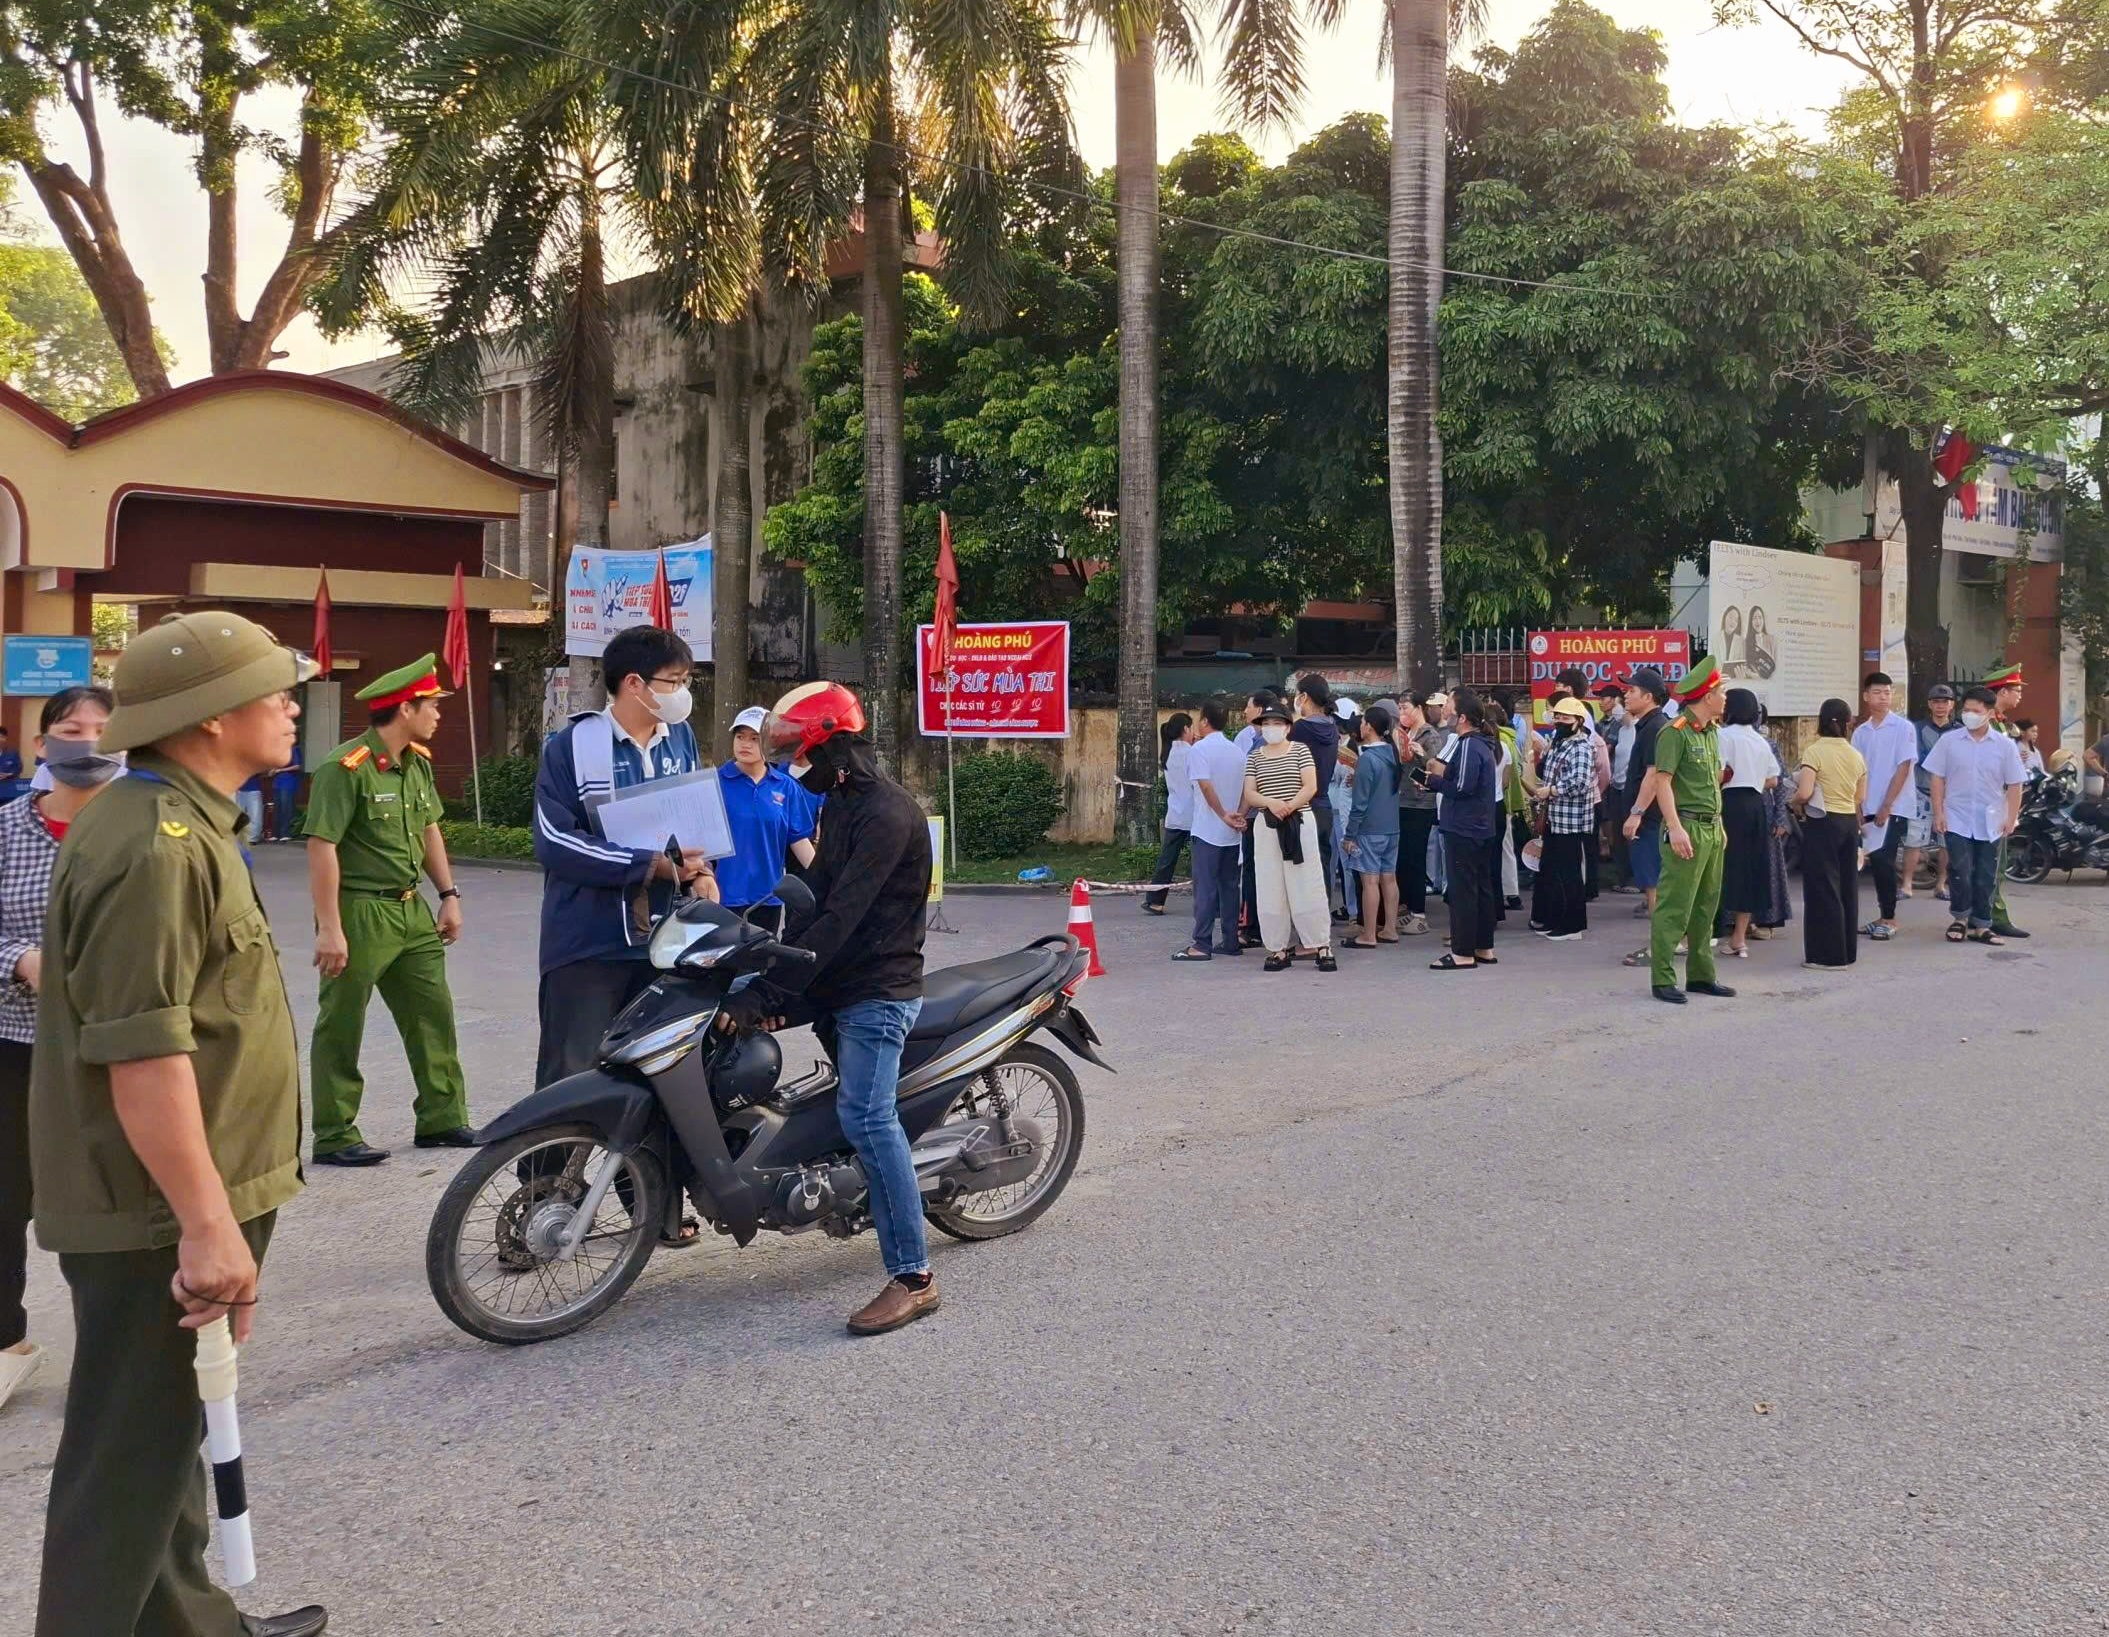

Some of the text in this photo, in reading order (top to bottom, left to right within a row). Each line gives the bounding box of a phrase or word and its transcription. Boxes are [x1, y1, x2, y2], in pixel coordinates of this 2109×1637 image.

[955, 630, 1032, 649] HOÀNG PHÚ
[1559, 636, 1618, 654] HOÀNG
[1622, 635, 1657, 654] PHÚ
[962, 669, 990, 693] SỨC
[992, 666, 1025, 694] MÙA
[1028, 671, 1056, 692] THI
[1532, 661, 1563, 681] DU
[939, 700, 955, 710] CHC
[956, 700, 968, 710] CÁC
[991, 700, 1001, 709] 10
[1011, 699, 1022, 709] 10
[1031, 697, 1042, 708] 10
